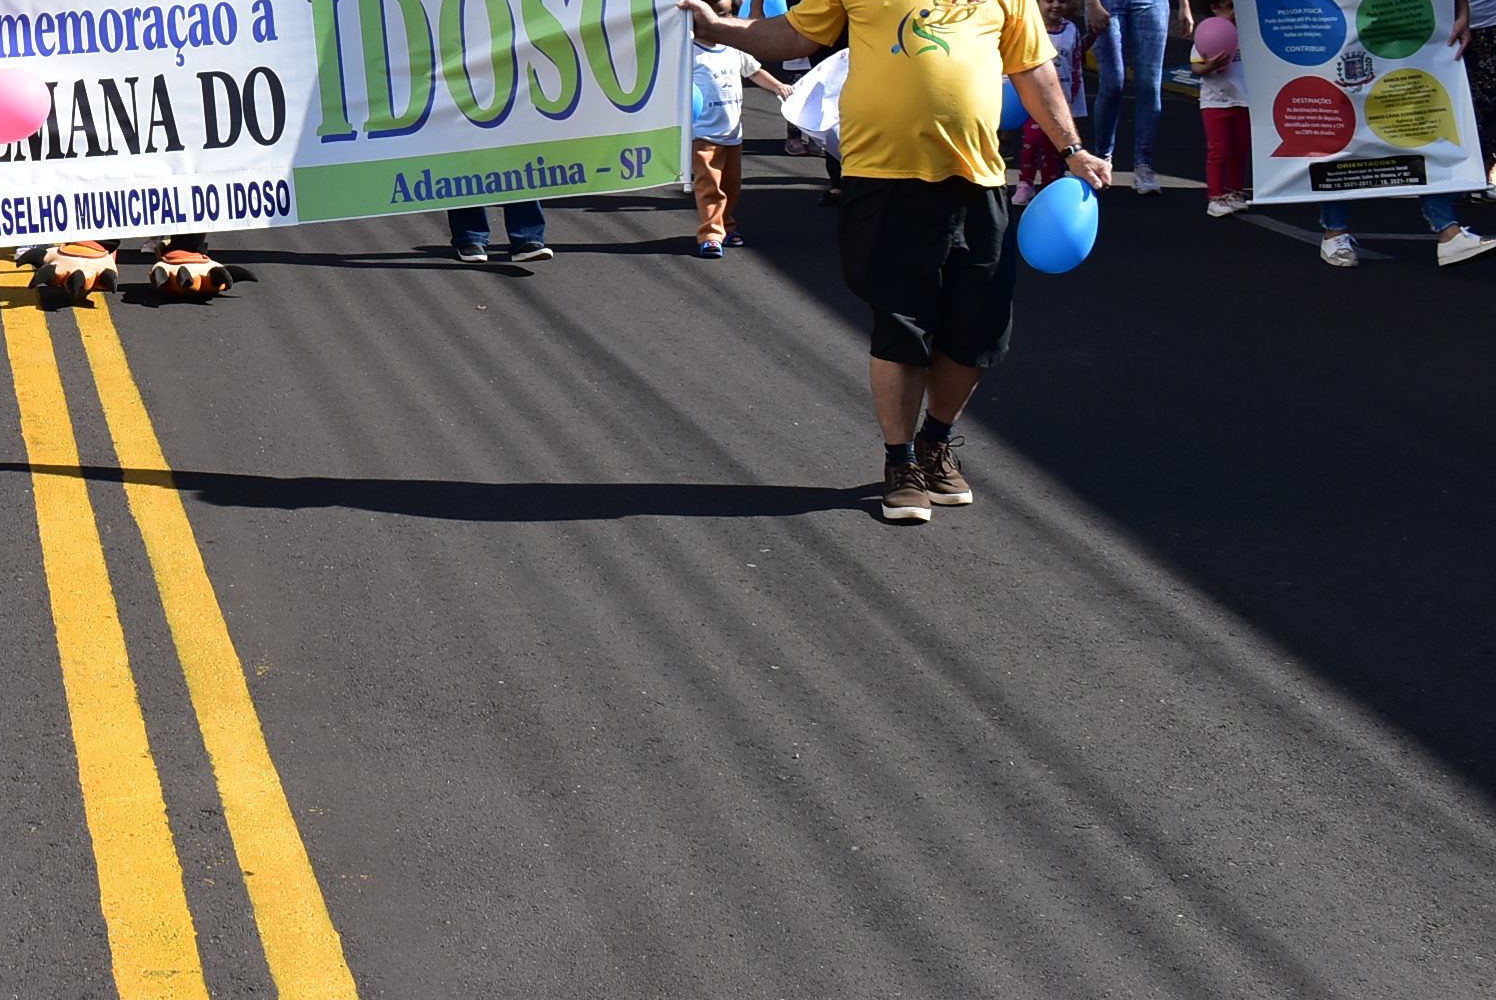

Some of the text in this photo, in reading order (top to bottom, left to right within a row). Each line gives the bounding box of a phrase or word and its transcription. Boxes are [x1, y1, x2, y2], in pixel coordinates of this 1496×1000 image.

[196, 65, 287, 151] DO
[390, 156, 586, 204] Adamantina
[619, 146, 652, 180] SP
[74, 186, 187, 230] MUNICIPAL
[192, 183, 220, 222] DO
[226, 179, 292, 219] IDOSO
